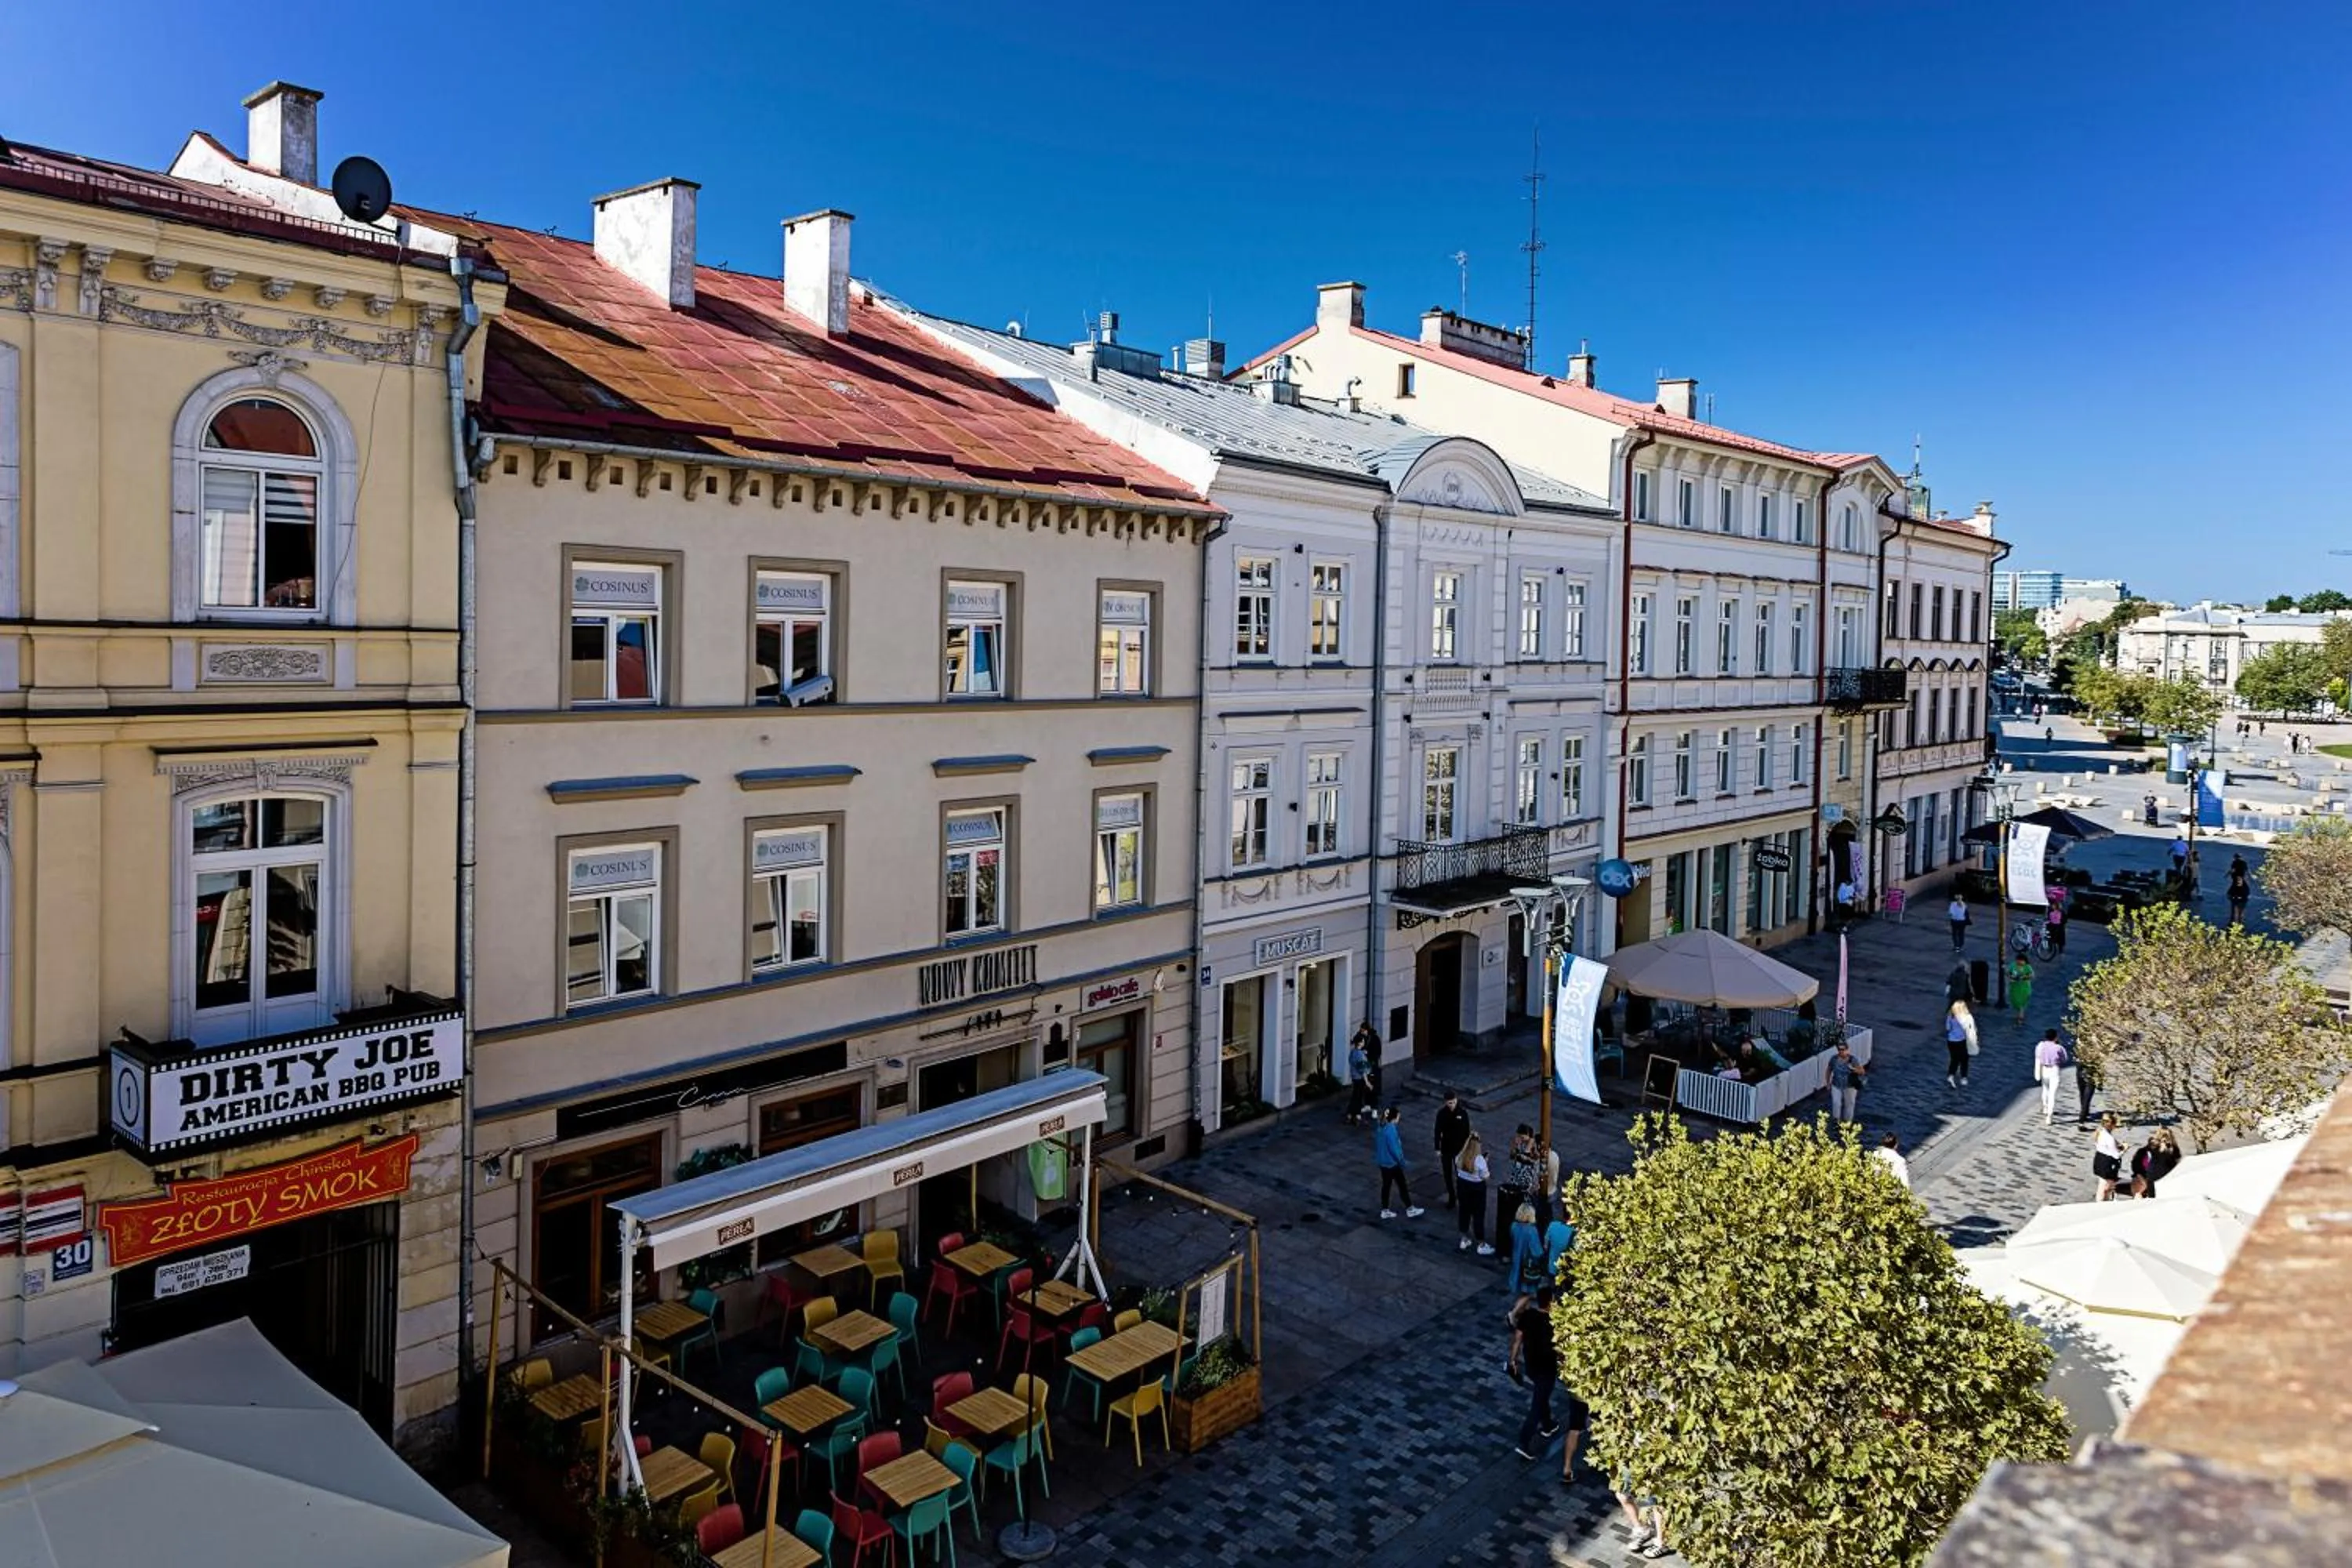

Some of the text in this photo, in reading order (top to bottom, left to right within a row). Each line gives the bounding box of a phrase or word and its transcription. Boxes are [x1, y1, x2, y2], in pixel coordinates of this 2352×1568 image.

[590, 579, 649, 594] COSINUS
[180, 1030, 434, 1105] DIRTY JOE
[180, 1061, 441, 1131] AMERICAN BBQ PUB
[182, 1178, 279, 1207] Restauracja
[278, 1166, 379, 1213] SMOK
[56, 1240, 91, 1269] 30
